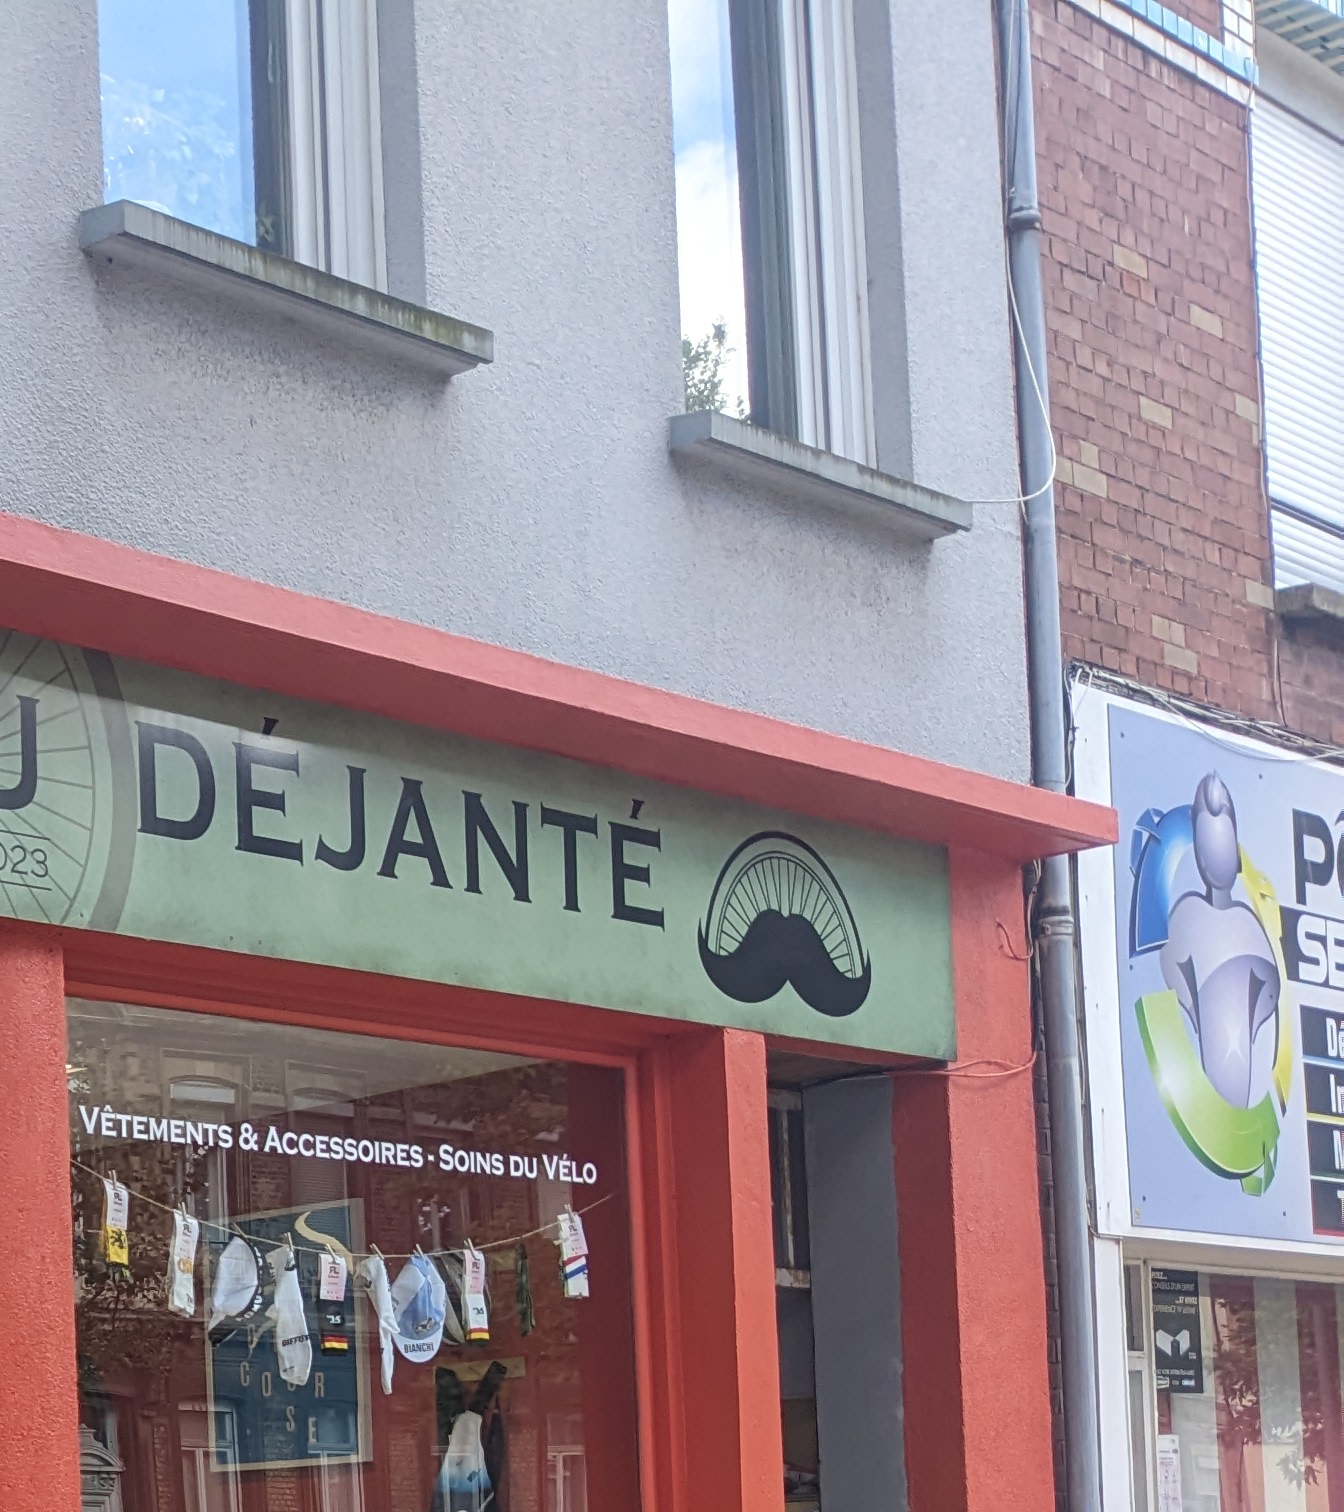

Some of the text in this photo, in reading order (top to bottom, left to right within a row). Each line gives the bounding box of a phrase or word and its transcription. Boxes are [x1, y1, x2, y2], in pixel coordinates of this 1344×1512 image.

[133, 716, 666, 930] DÉJANTÉ
[239, 1122, 259, 1152] &
[509, 1157, 538, 1179] DU
